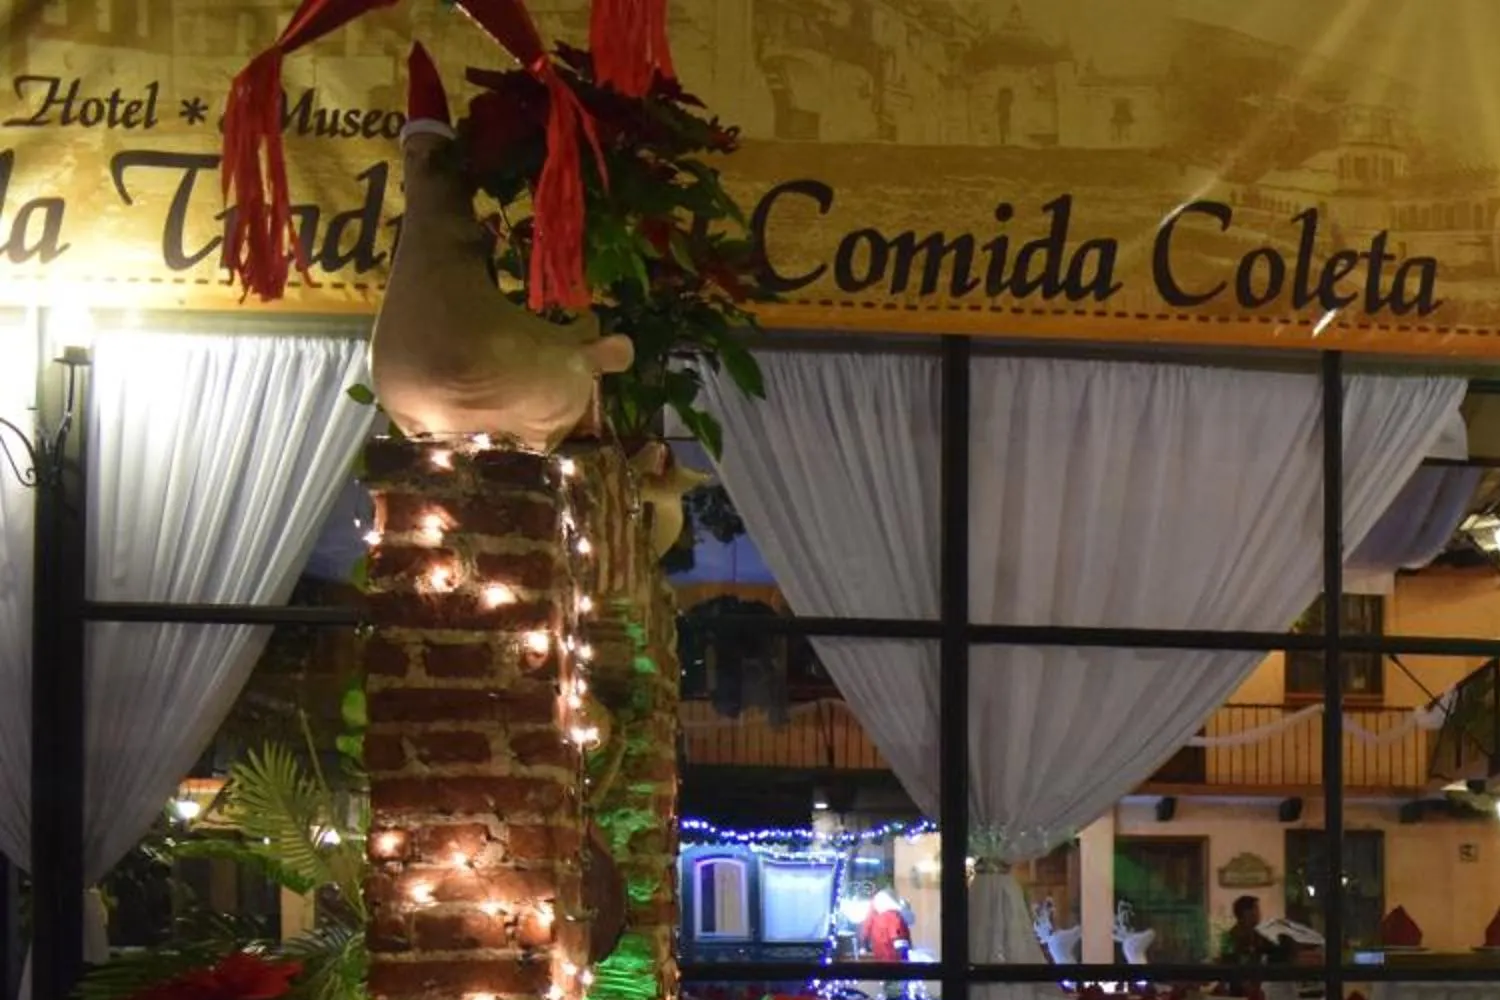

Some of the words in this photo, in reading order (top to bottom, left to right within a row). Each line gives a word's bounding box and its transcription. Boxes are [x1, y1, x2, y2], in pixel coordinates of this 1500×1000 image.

[3, 75, 160, 129] Hotel
[750, 178, 1123, 301] Comida
[1152, 201, 1443, 316] Coleta
